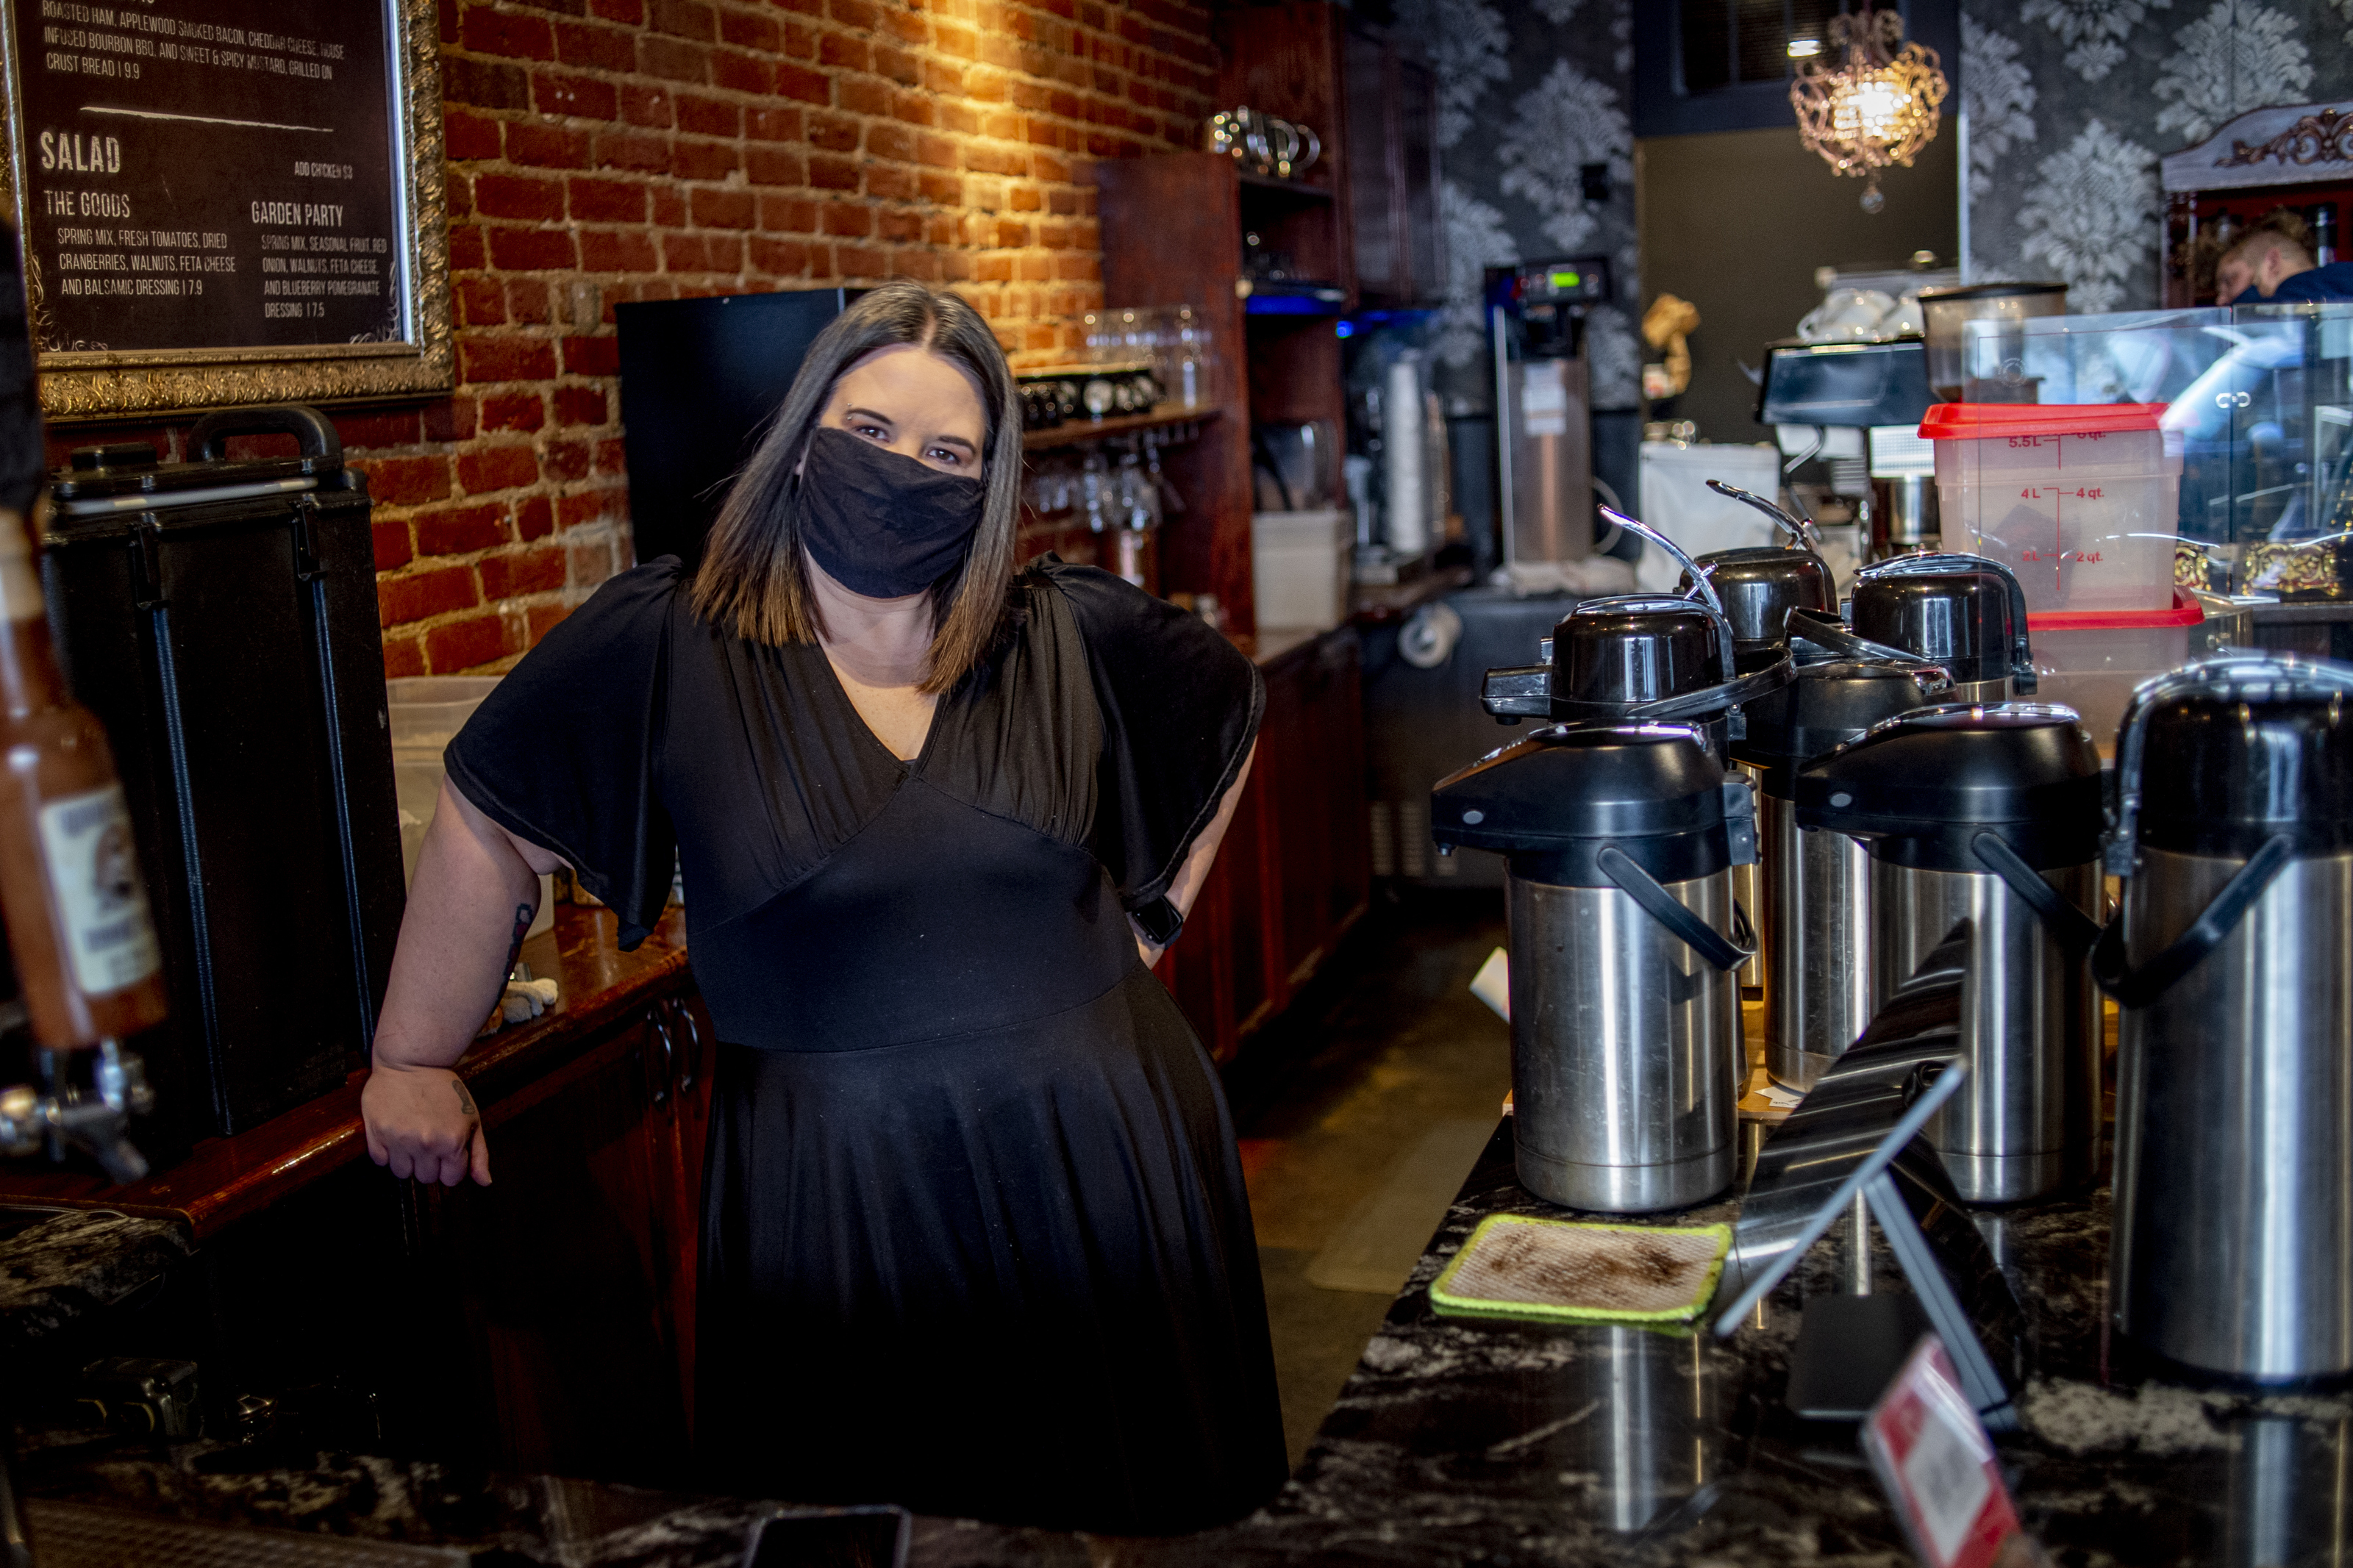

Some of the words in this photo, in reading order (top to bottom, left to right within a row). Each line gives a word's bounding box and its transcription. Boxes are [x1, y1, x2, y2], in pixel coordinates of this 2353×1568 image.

[43, 1, 89, 22] ROASTED
[92, 7, 117, 26] HAM,
[121, 11, 176, 35] APPLEWOOD
[179, 21, 214, 40] SMOKED
[249, 31, 286, 51] CHEDDAR
[44, 26, 86, 48] INFUSED
[89, 32, 133, 54] BOURBON
[160, 42, 177, 59] AND
[180, 45, 210, 63] SWEET
[213, 50, 219, 65] &
[221, 51, 244, 68] SPICY
[289, 60, 320, 78] GRILLED
[321, 65, 332, 80] ON
[46, 52, 78, 72] CRUST
[82, 57, 115, 76] BREAD
[124, 62, 140, 79] 9.9
[40, 131, 121, 173] SALAD
[294, 161, 310, 176] ADD
[43, 190, 75, 215] THE
[80, 192, 130, 218] GOODS
[251, 201, 301, 225] GARDEN
[304, 204, 343, 227] PARTY
[57, 228, 93, 245] SPRING
[96, 229, 116, 246] MIX,
[119, 230, 149, 246] FRESH
[151, 231, 201, 249] TOMATOES,
[203, 232, 227, 249] DRIED
[261, 235, 290, 250] SPRING
[60, 253, 129, 272] CRANBERRIES,
[131, 254, 178, 272] WALNUTS,
[180, 256, 202, 271] FETA
[204, 257, 236, 272] CHEESE
[330, 258, 349, 274] FETA
[62, 279, 82, 295] AND
[85, 279, 134, 295] BALSAMIC
[136, 279, 179, 296] DRESSING
[188, 279, 202, 295] 7.9
[265, 280, 281, 296] AND
[265, 302, 303, 318] DRESSING
[2021, 488, 2029, 499] 4
[2032, 488, 2041, 498] L
[2076, 487, 2085, 498] 4
[2088, 487, 2105, 500] qt.
[2076, 551, 2085, 562] 2
[2087, 551, 2104, 564] qt.
